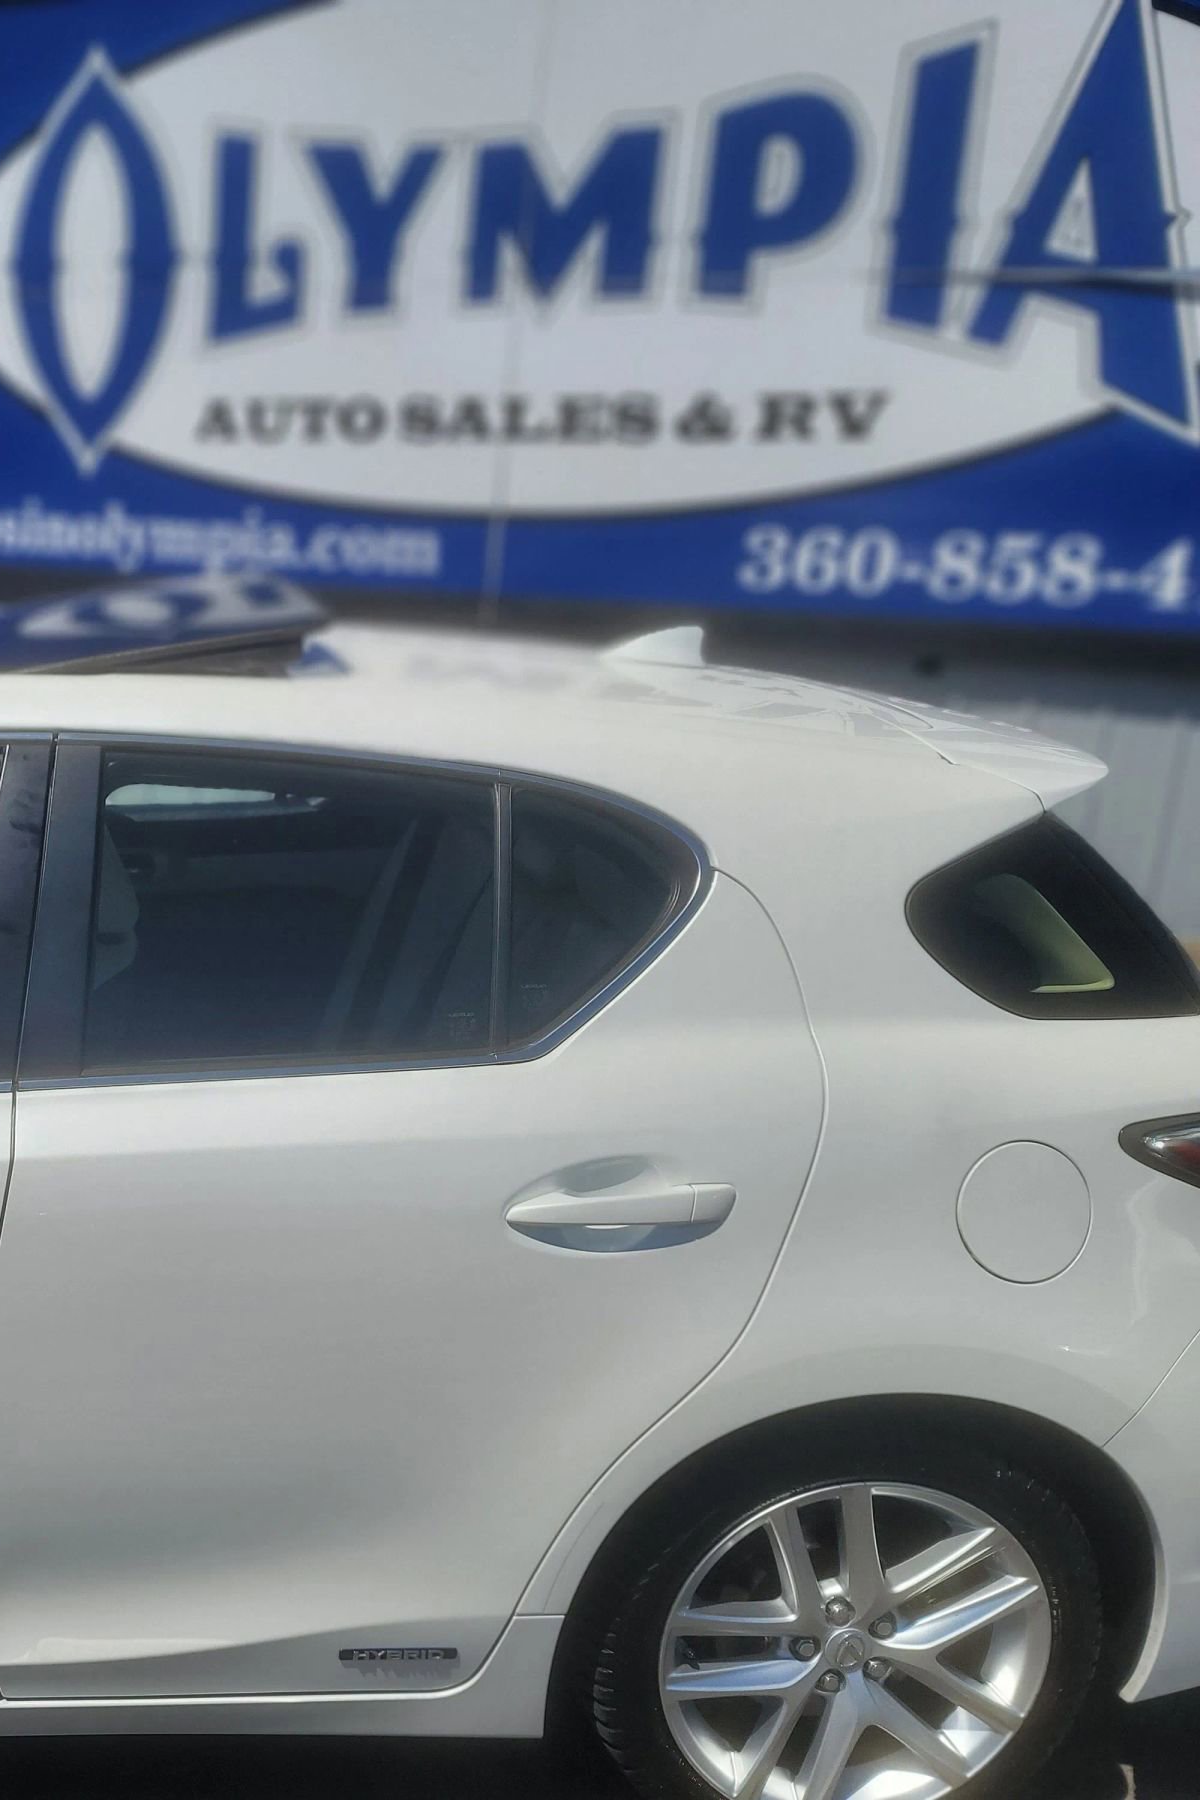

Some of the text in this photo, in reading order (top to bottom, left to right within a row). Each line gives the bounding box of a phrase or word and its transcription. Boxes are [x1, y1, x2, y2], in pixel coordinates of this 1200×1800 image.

[10, 0, 1200, 470] OLYMPIA
[194, 387, 891, 446] AUTO SALES & RV
[737, 521, 1196, 613] 360-858-4
[352, 1649, 445, 1661] HYBRID
